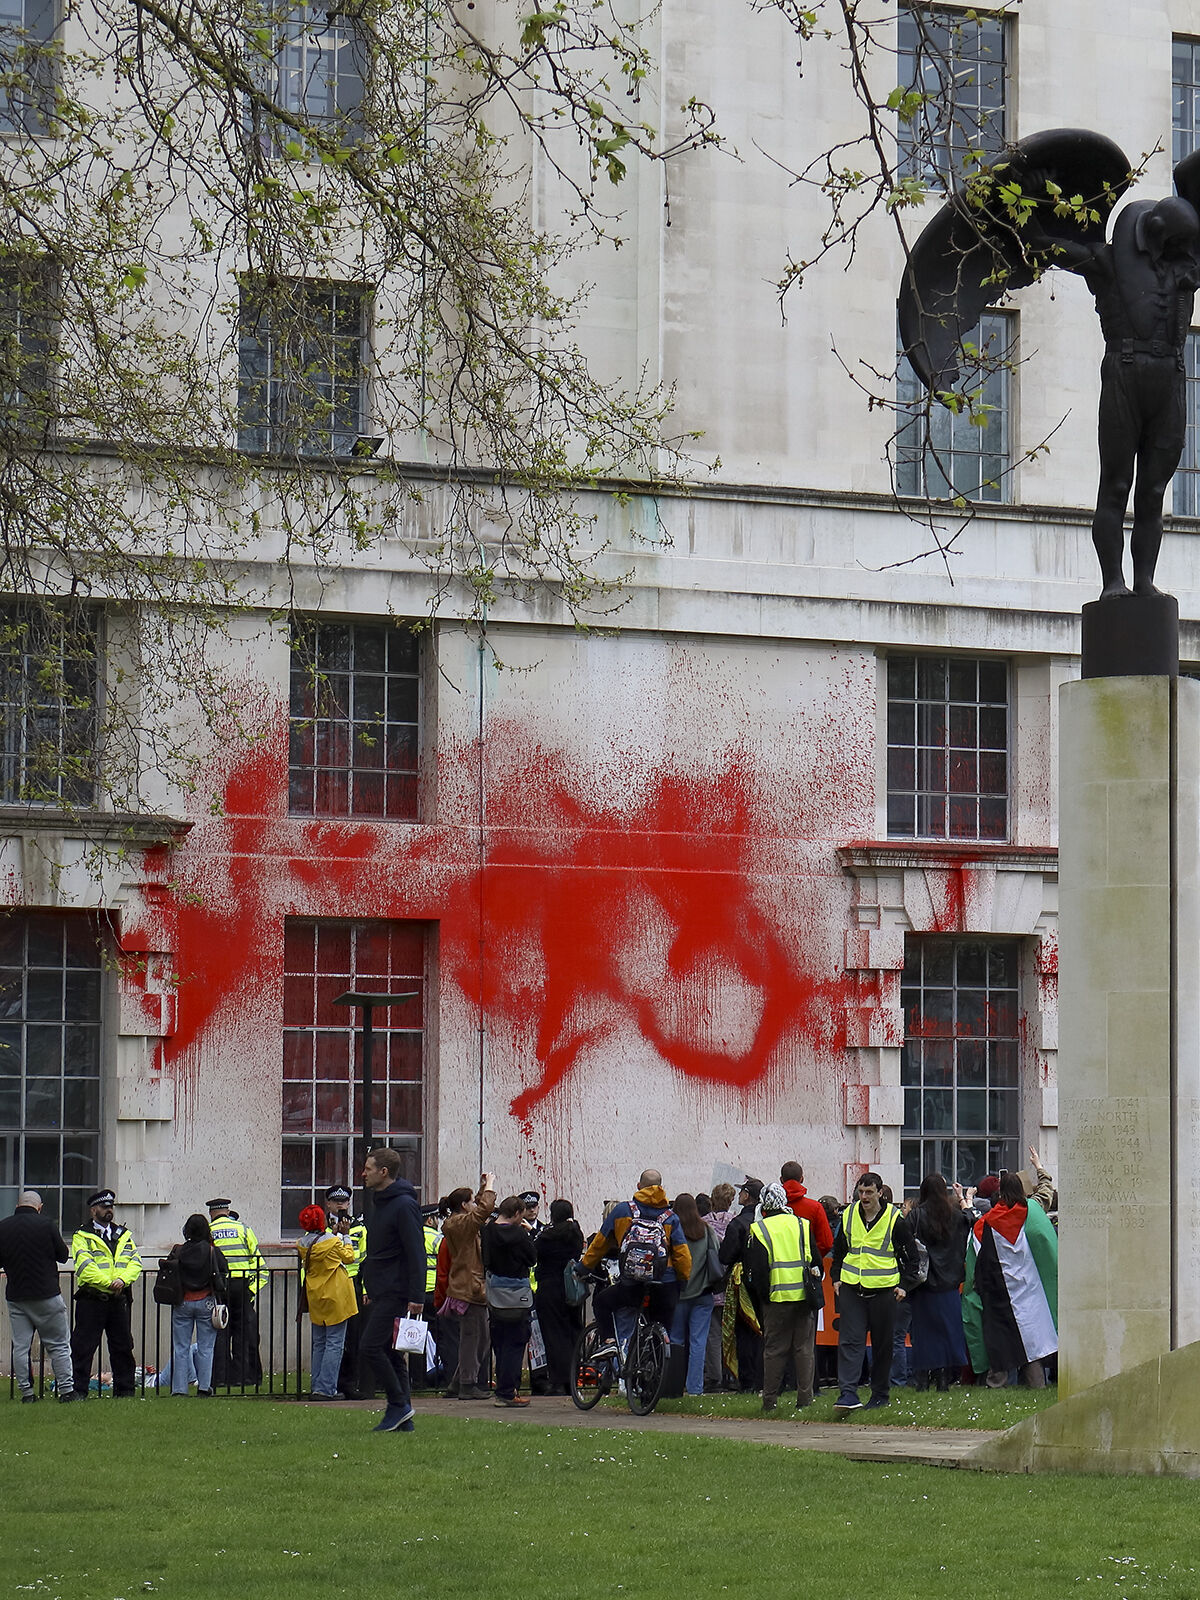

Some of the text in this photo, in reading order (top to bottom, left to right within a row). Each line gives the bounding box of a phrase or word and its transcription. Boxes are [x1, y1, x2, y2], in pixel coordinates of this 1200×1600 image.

[1097, 1111, 1138, 1122] NORTH
[1112, 1125, 1136, 1136] 1943
[1116, 1138, 1140, 1149] 1944
[1082, 1151, 1124, 1162] SABANG
[1120, 1204, 1146, 1216] 1950
[1120, 1217, 1145, 1229] 1982
[213, 1231, 238, 1239] POLICE
